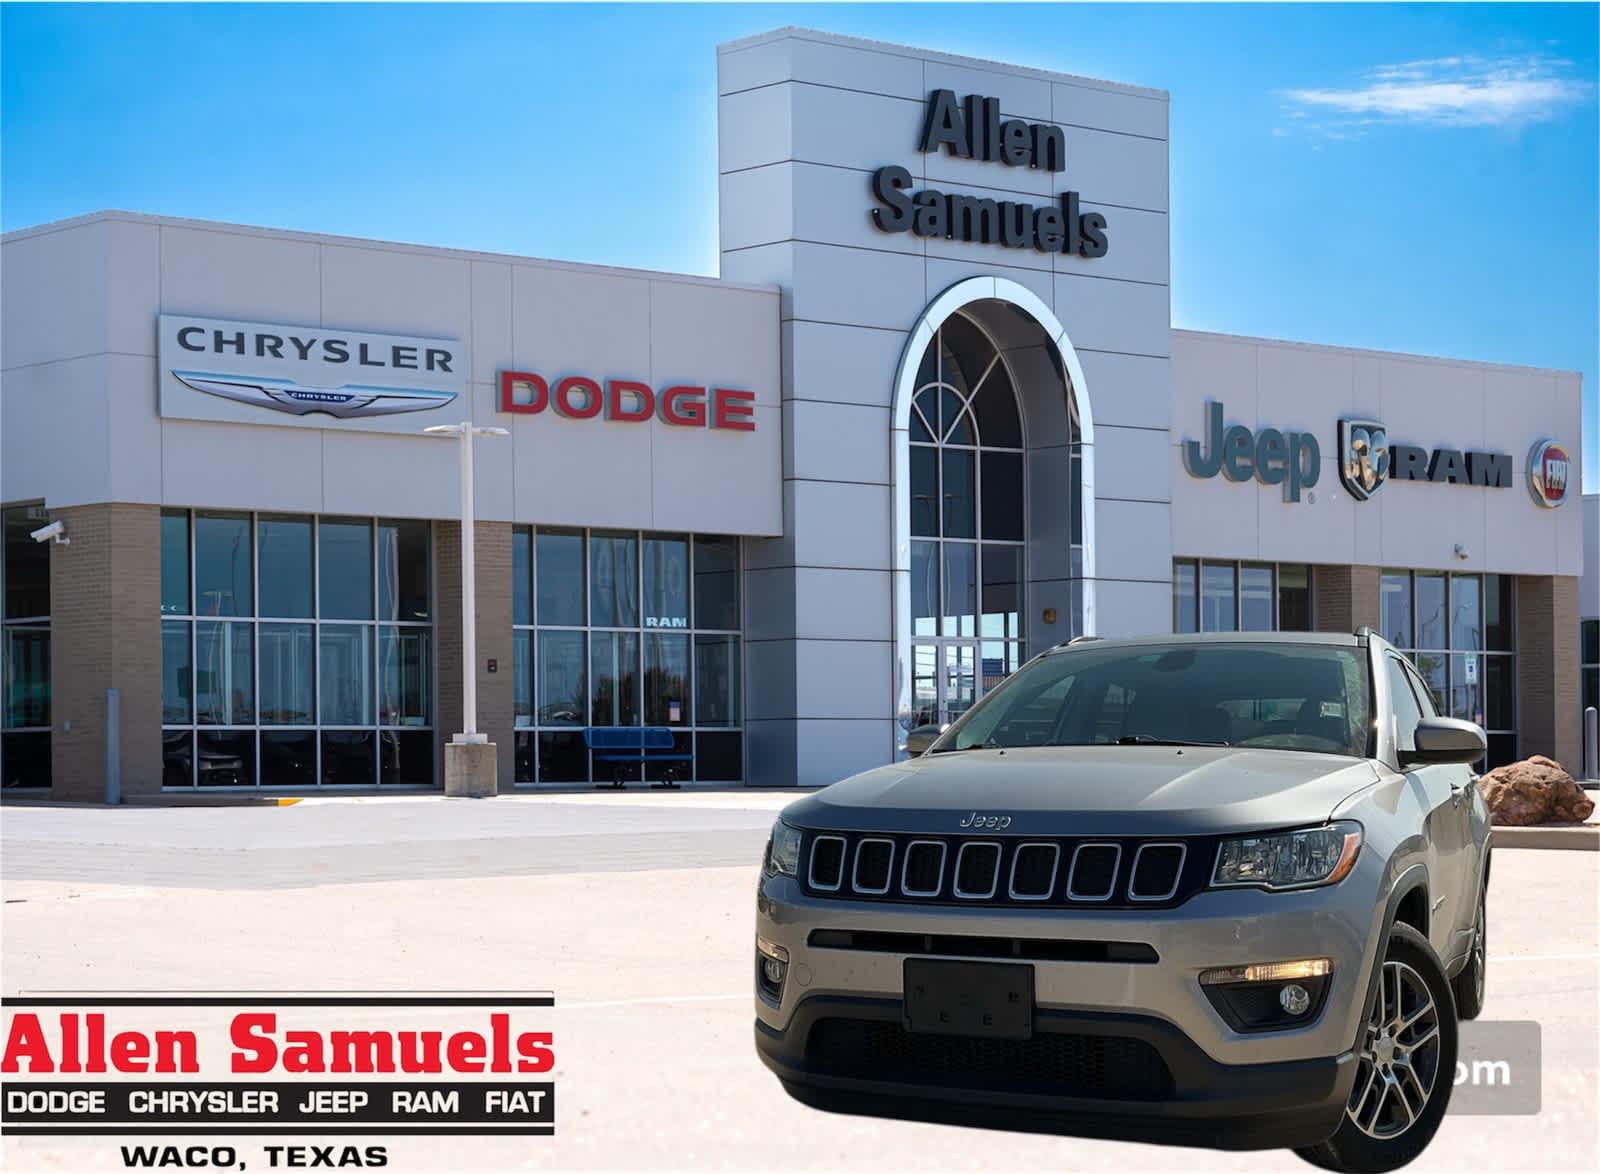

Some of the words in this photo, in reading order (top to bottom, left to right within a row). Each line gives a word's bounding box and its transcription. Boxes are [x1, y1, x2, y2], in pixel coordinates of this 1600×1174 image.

[919, 89, 1066, 172] Allen
[870, 165, 1108, 258] Samuels
[177, 326, 453, 373] CHRYSLER
[291, 392, 347, 401] CHRYSLER
[498, 370, 756, 432] DODGE
[1183, 401, 1320, 503] Jeep
[1389, 445, 1512, 488] RAM
[645, 616, 688, 628] RAM
[959, 811, 1012, 831] Jeep
